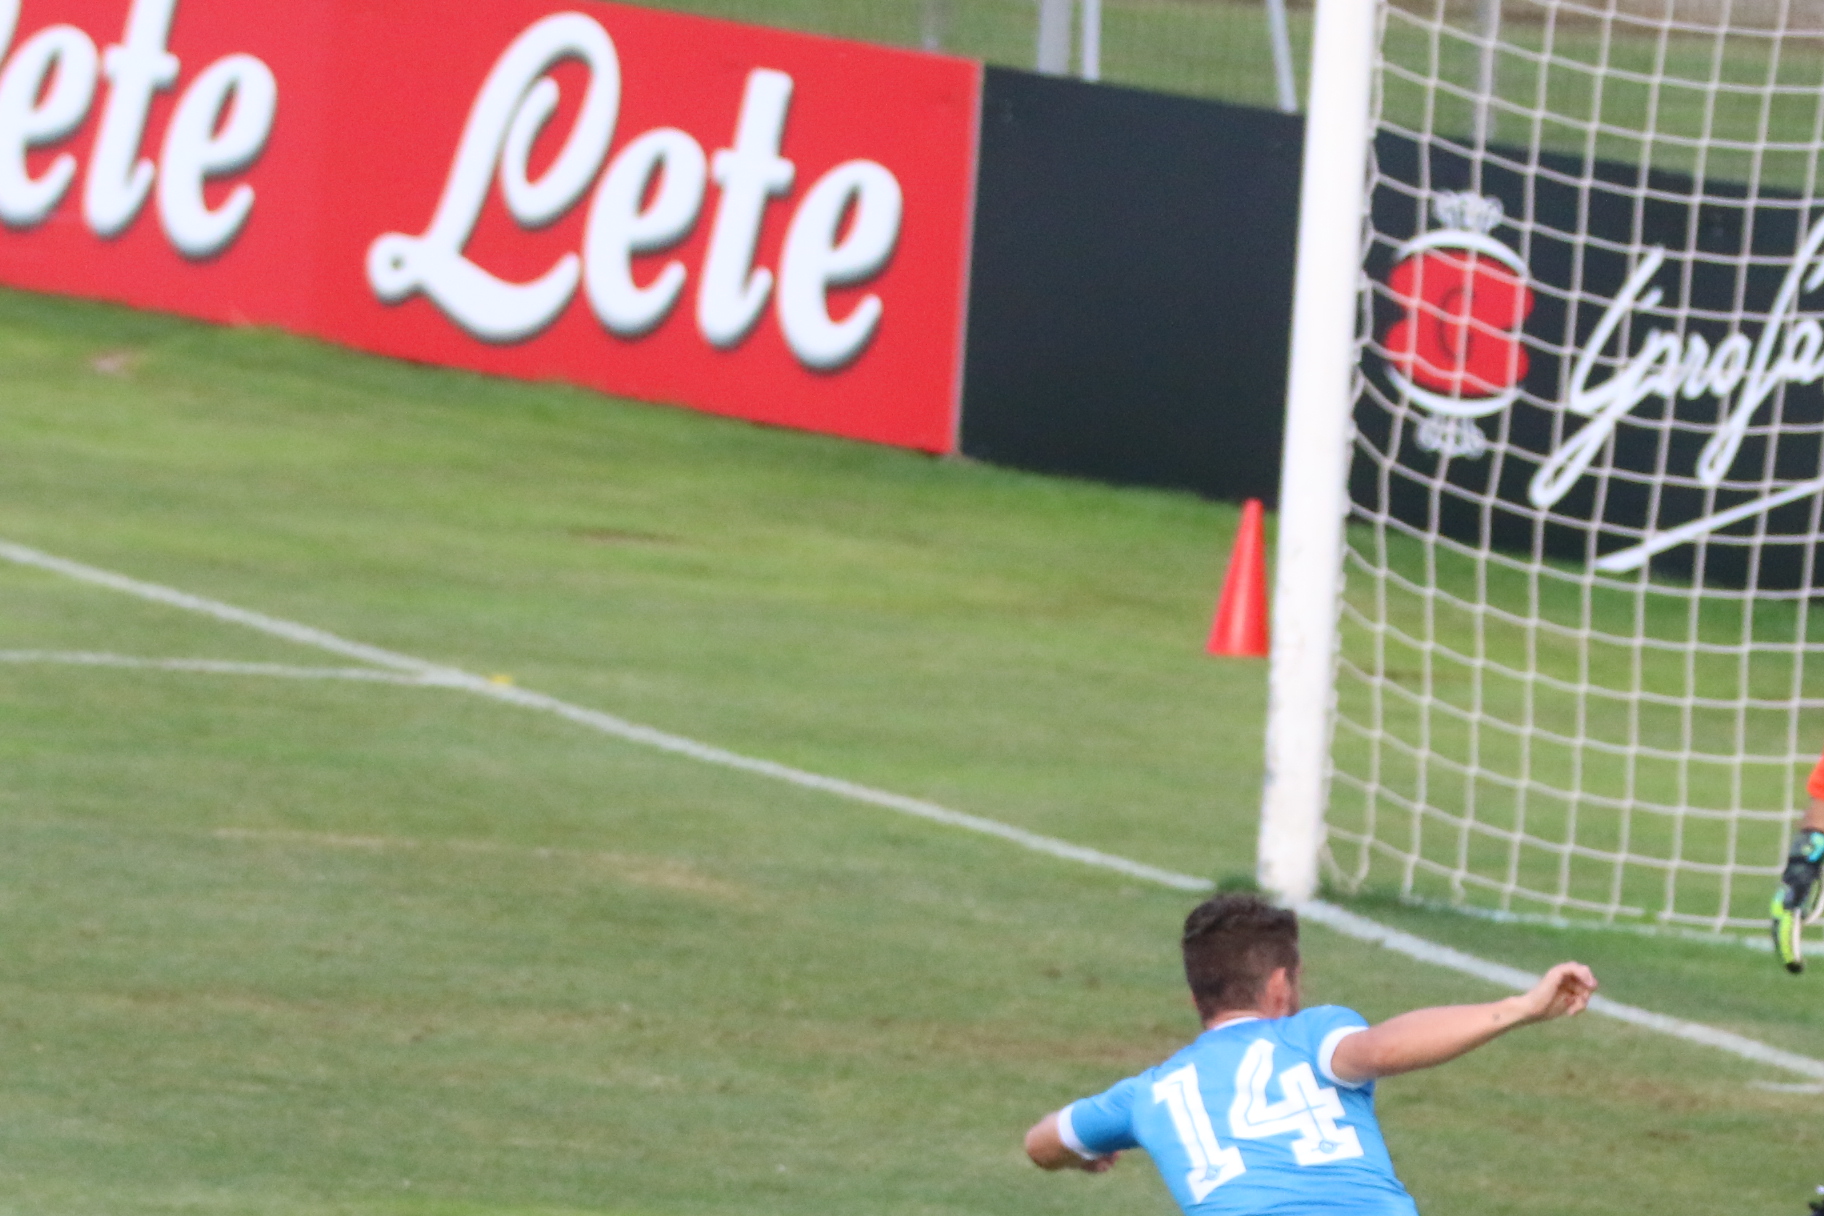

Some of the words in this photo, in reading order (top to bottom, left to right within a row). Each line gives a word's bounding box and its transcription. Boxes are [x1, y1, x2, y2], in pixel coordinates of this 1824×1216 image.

[0, 0, 279, 260] ete
[366, 11, 904, 371] Lete
[1152, 1039, 1364, 1202] 14
